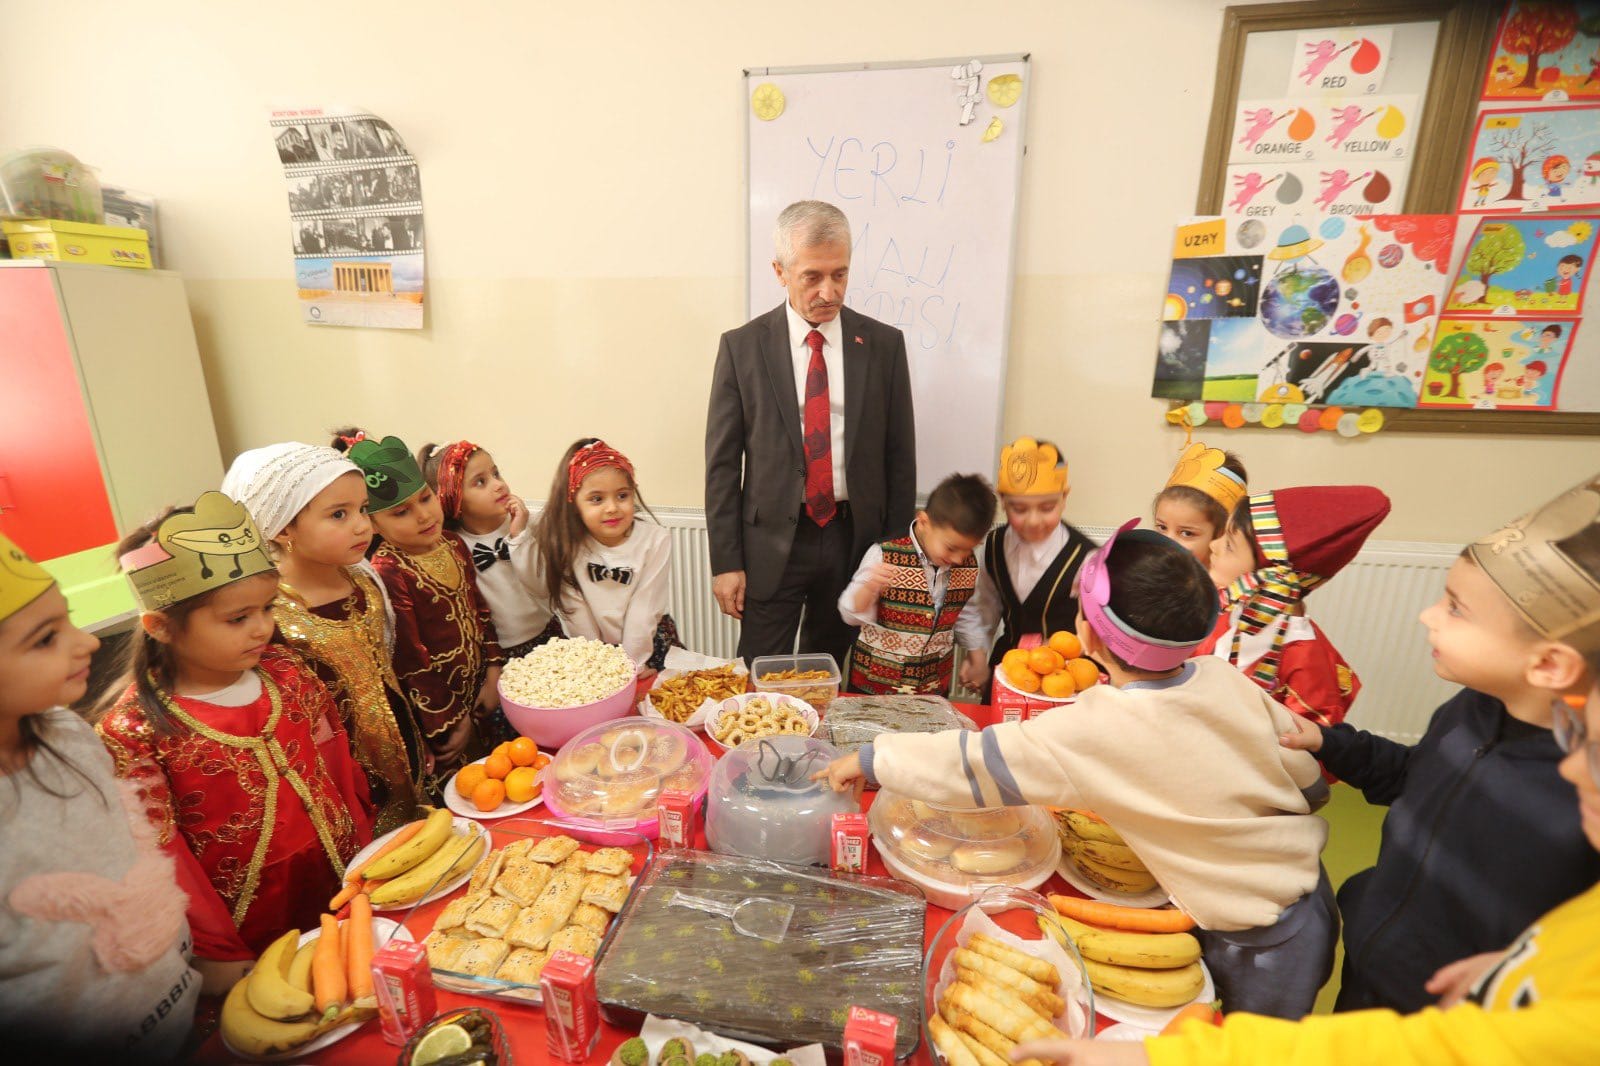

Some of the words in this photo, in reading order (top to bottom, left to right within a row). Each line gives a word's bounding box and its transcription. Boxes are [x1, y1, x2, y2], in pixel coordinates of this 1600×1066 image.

[1321, 75, 1347, 88] RED
[1254, 142, 1303, 155] ORANGE
[1343, 140, 1391, 153] YELLOW
[1246, 205, 1276, 217] GREY
[1330, 204, 1374, 216] BROWN
[1184, 232, 1219, 247] UZAY
